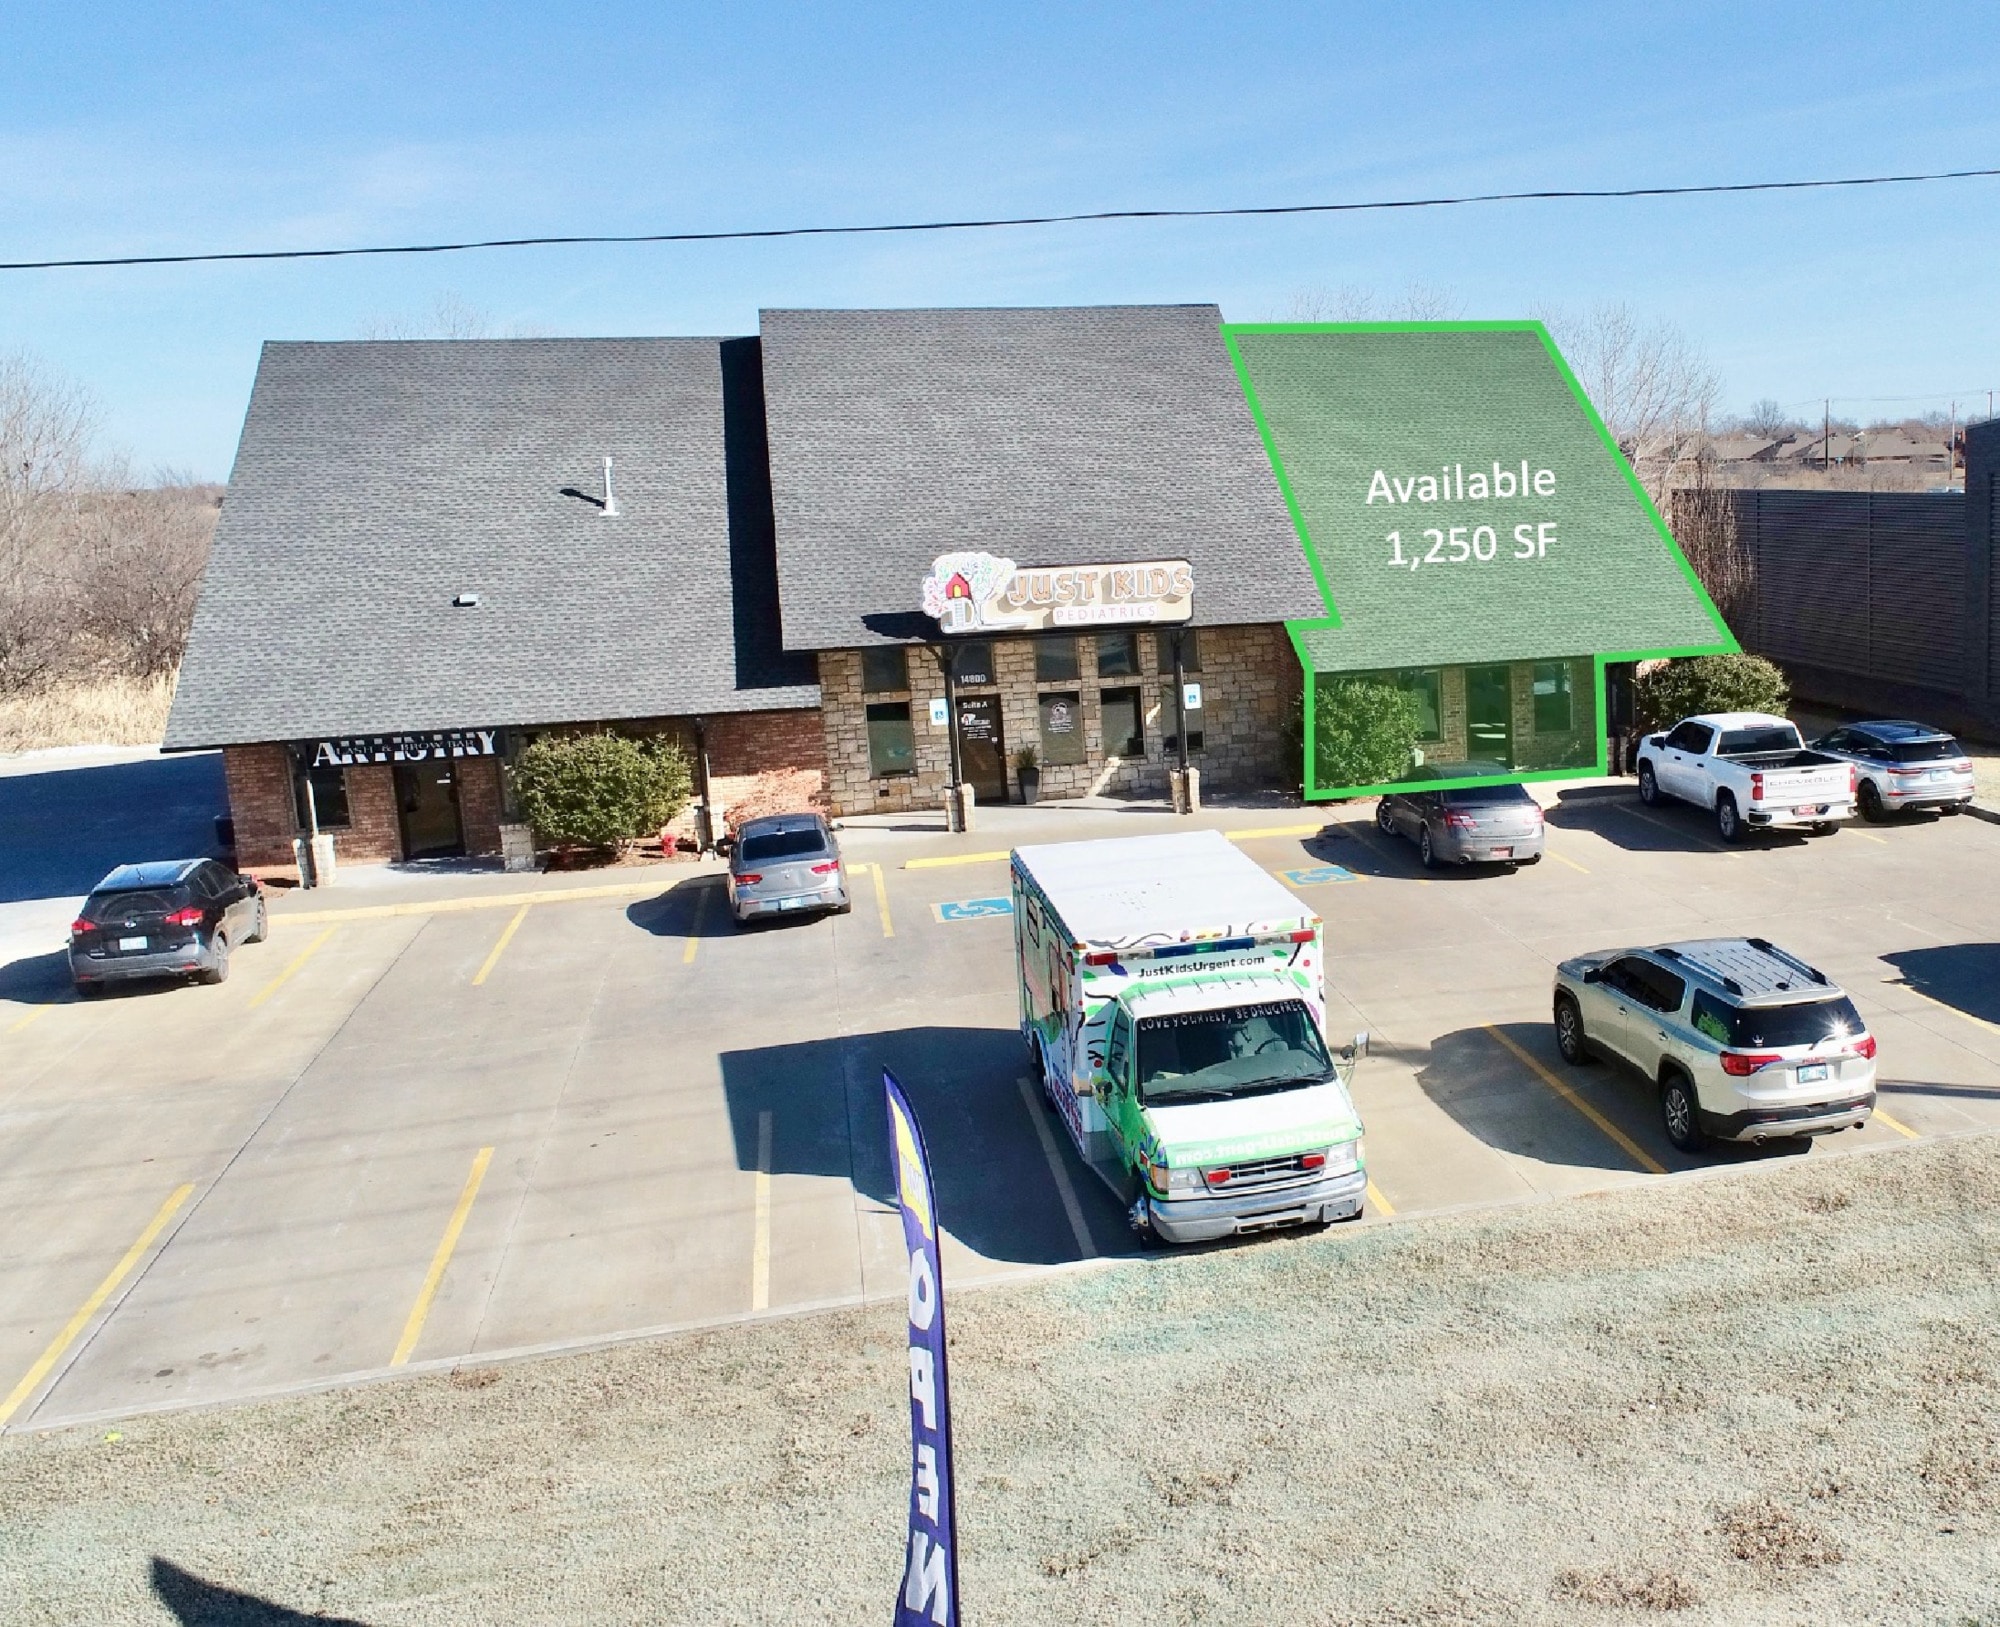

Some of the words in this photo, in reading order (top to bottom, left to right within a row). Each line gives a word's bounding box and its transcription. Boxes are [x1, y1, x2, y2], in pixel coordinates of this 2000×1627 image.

[1009, 570, 1099, 606] JUST
[1111, 566, 1194, 598] KIDS
[1055, 605, 1156, 621] PEDIATRICS
[382, 743, 393, 752] &
[400, 739, 443, 752] BROW
[448, 739, 475, 749] BAR
[1769, 775, 1843, 787] CHEVROLET
[1138, 955, 1265, 978] JustKidsUrgent.com
[1139, 1017, 1170, 1031] LOVE
